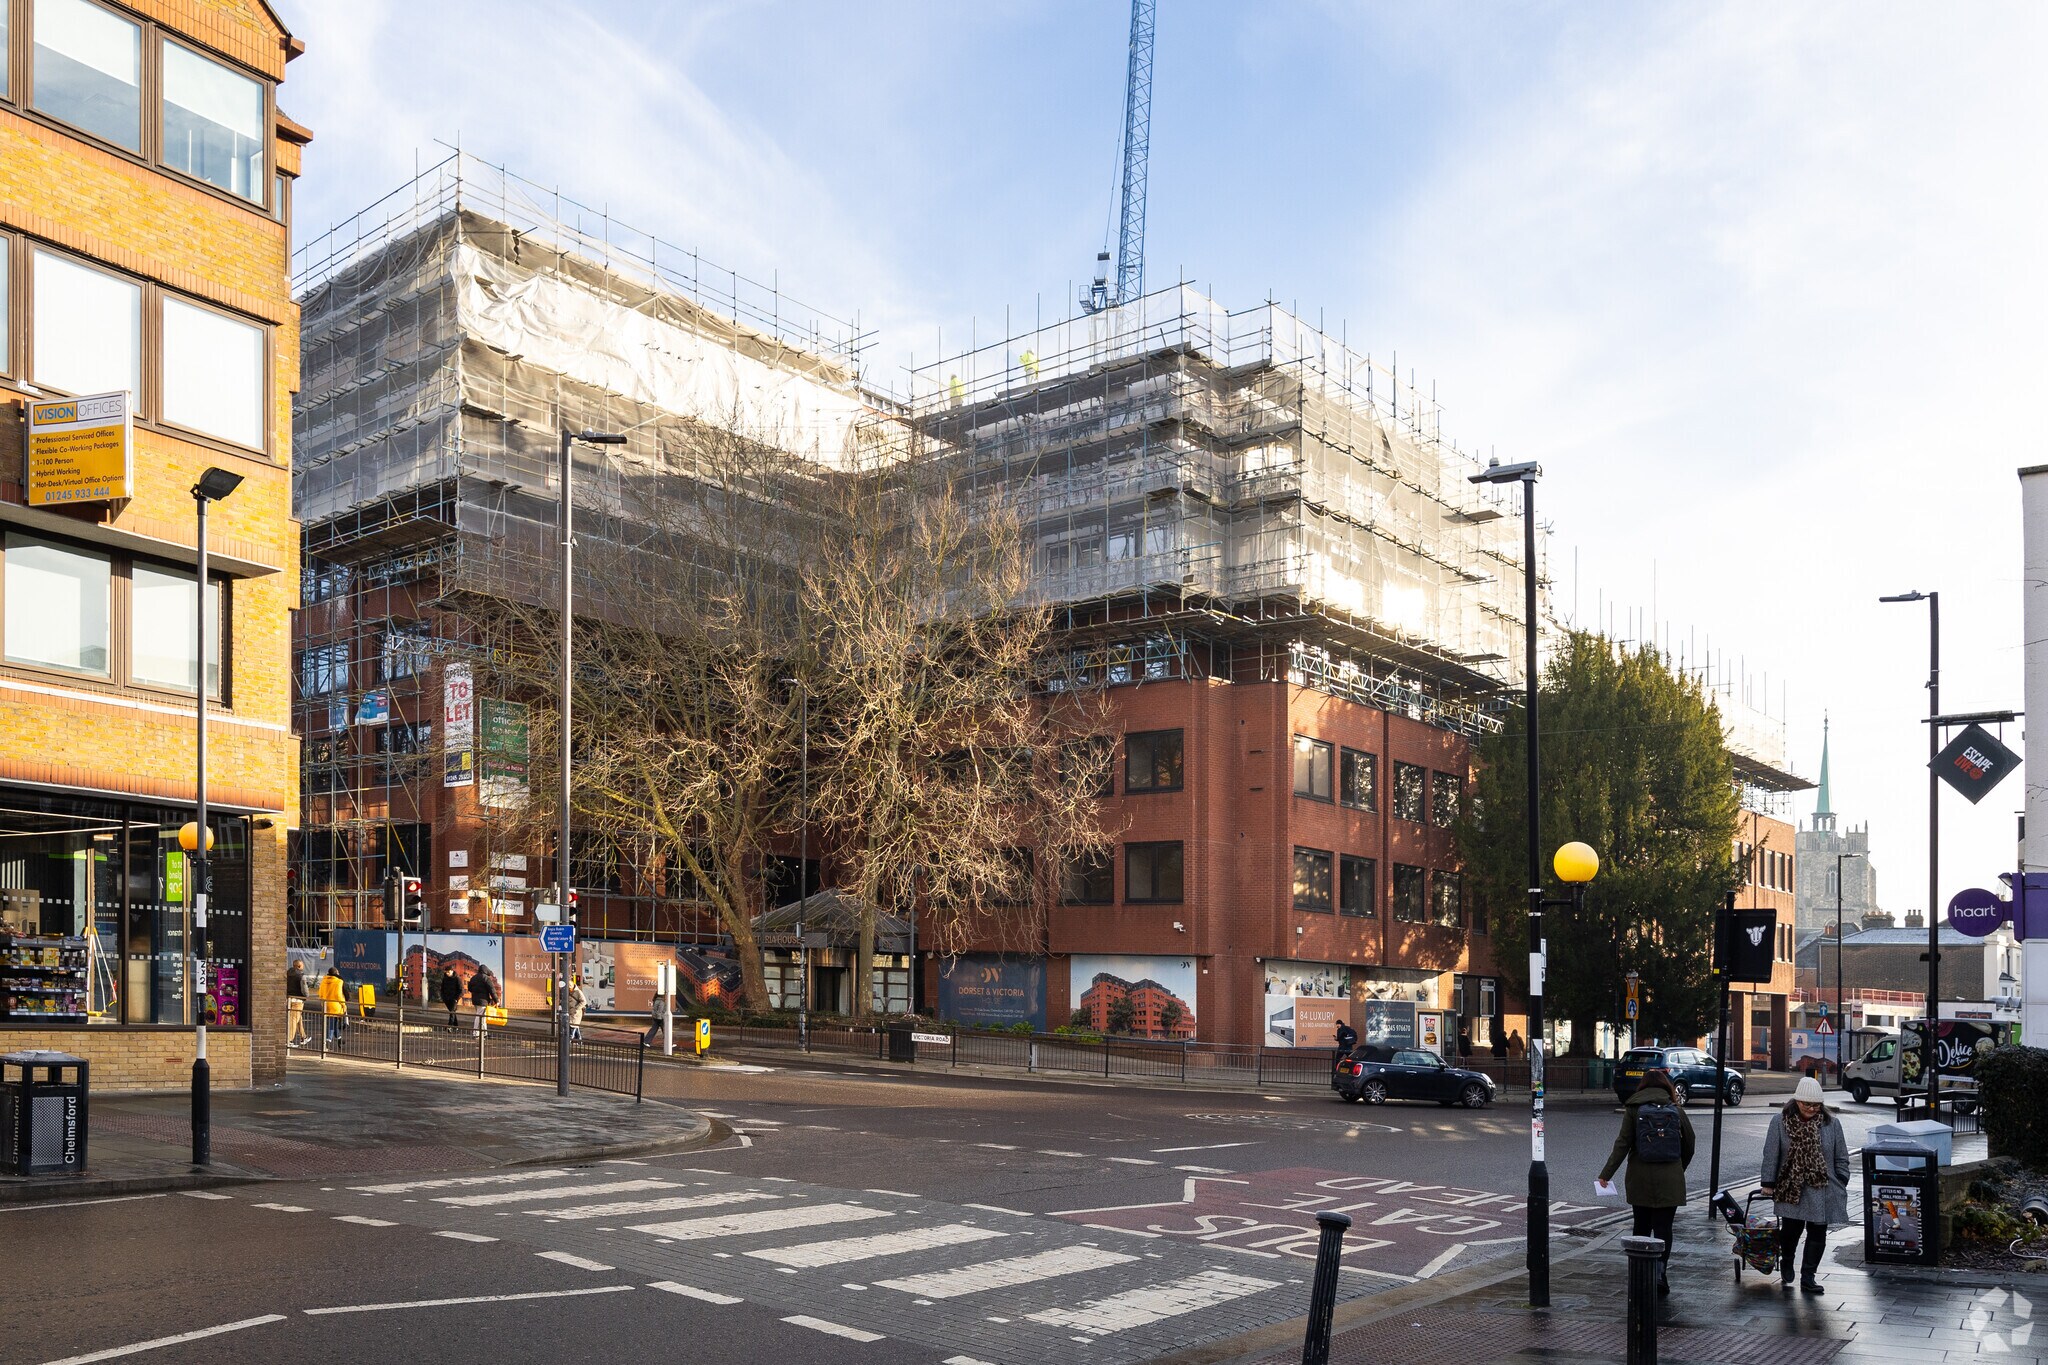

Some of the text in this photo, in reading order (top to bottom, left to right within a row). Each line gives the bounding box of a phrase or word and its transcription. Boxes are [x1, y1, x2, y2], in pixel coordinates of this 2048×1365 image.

[36, 400, 122, 420] VISION OFFICES
[36, 435, 70, 444] Professional
[72, 432, 94, 440] Serviced
[36, 441, 119, 454] Flexible Co-Working Packages
[36, 470, 54, 478] Hybrid
[36, 474, 124, 488] Hot-Desk/Virtual Office Options
[46, 486, 110, 501] 01245 933 444
[450, 682, 468, 699] TO
[446, 703, 472, 722] LET
[1954, 754, 1973, 772] LIVE
[1962, 746, 1994, 772] ESCAPE
[1954, 904, 1996, 918] haart
[514, 961, 528, 971] 84
[958, 986, 1024, 997] DORSET & VICTORIA
[1300, 1010, 1336, 1020] 84 LUXURY
[65, 1096, 76, 1164] Chelmsford
[1315, 1176, 1606, 1216] AHEAD
[1240, 1192, 1502, 1236] GATE
[1148, 1214, 1396, 1259] BUS
